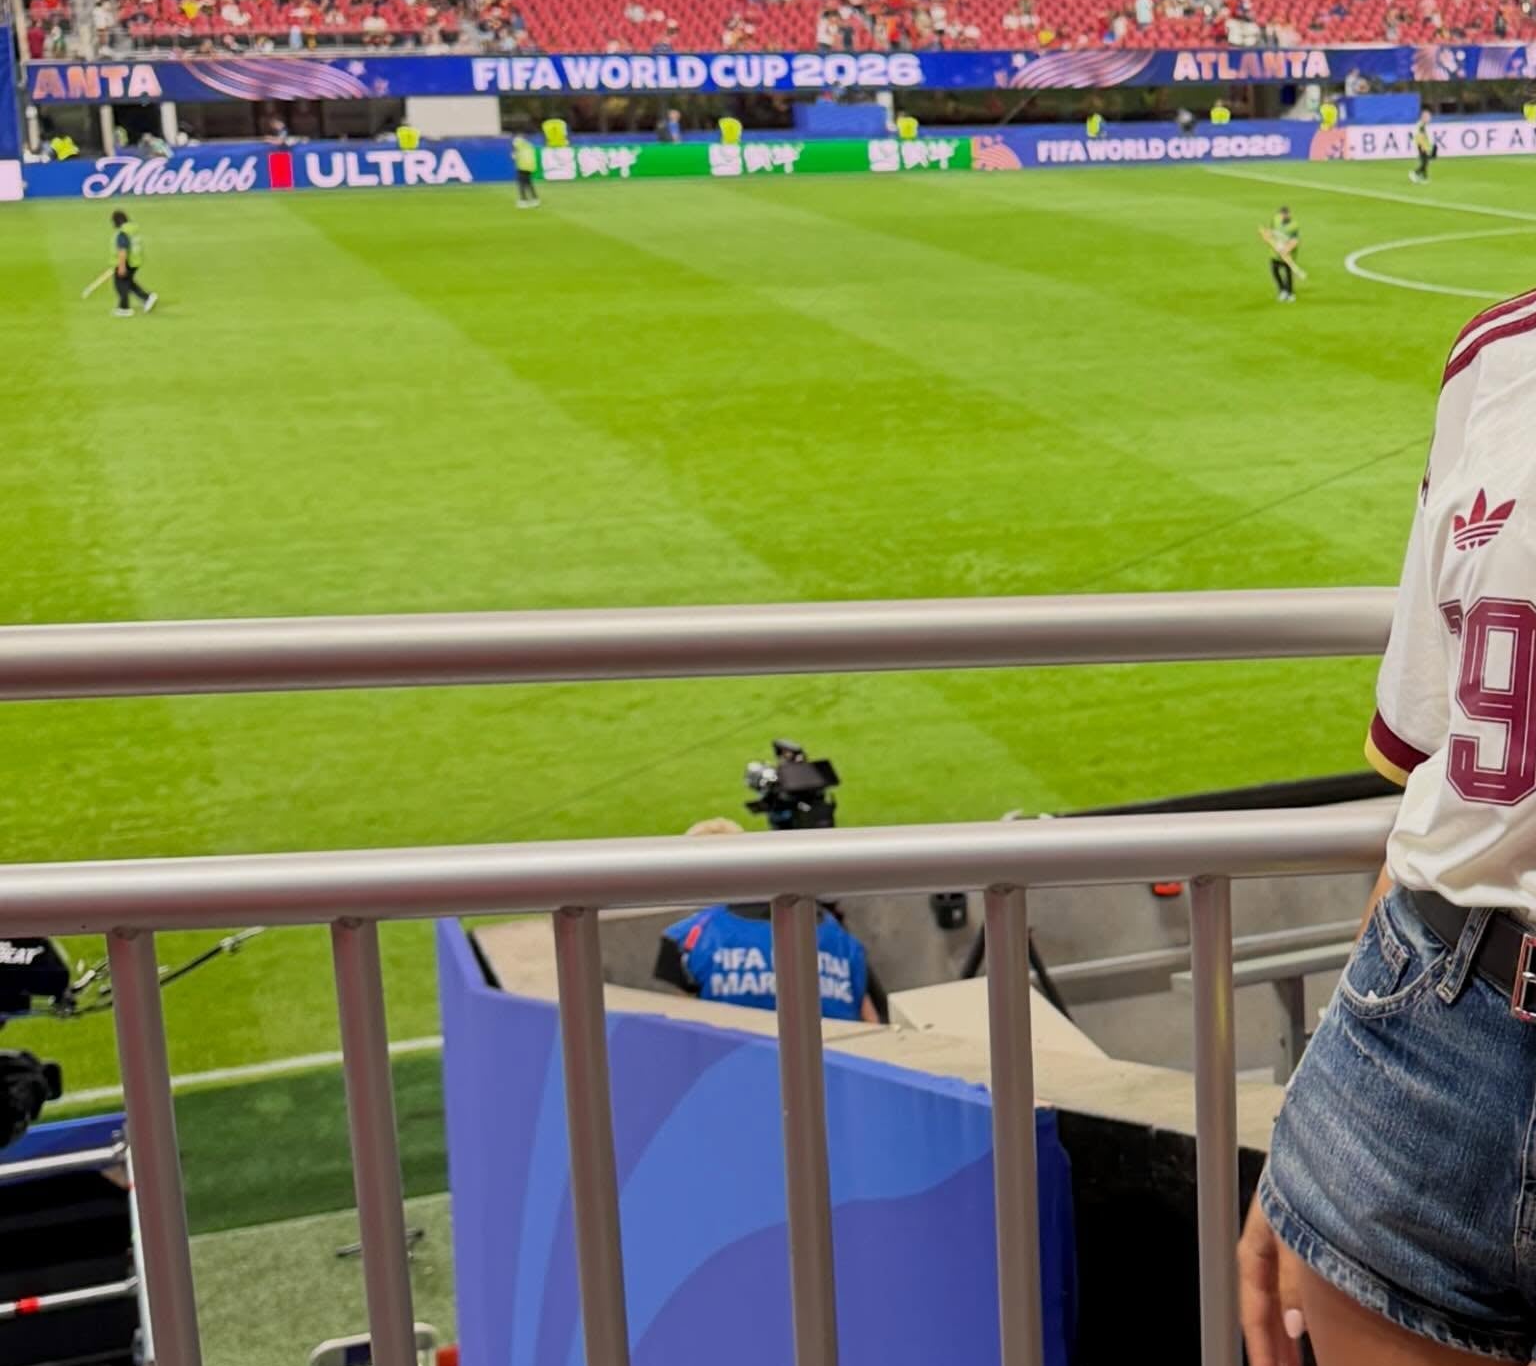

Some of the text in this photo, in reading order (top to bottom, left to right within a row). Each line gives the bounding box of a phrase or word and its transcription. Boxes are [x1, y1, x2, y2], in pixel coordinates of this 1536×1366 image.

[471, 53, 923, 91] FIFA WORLD CUP 2026
[1173, 51, 1330, 81] ATLANTA
[1037, 140, 1086, 163] FIFA
[1087, 138, 1166, 161] WORLD
[1167, 137, 1209, 159] CUP
[1461, 128, 1500, 150] OF
[83, 150, 473, 198] Michelob ULTRA
